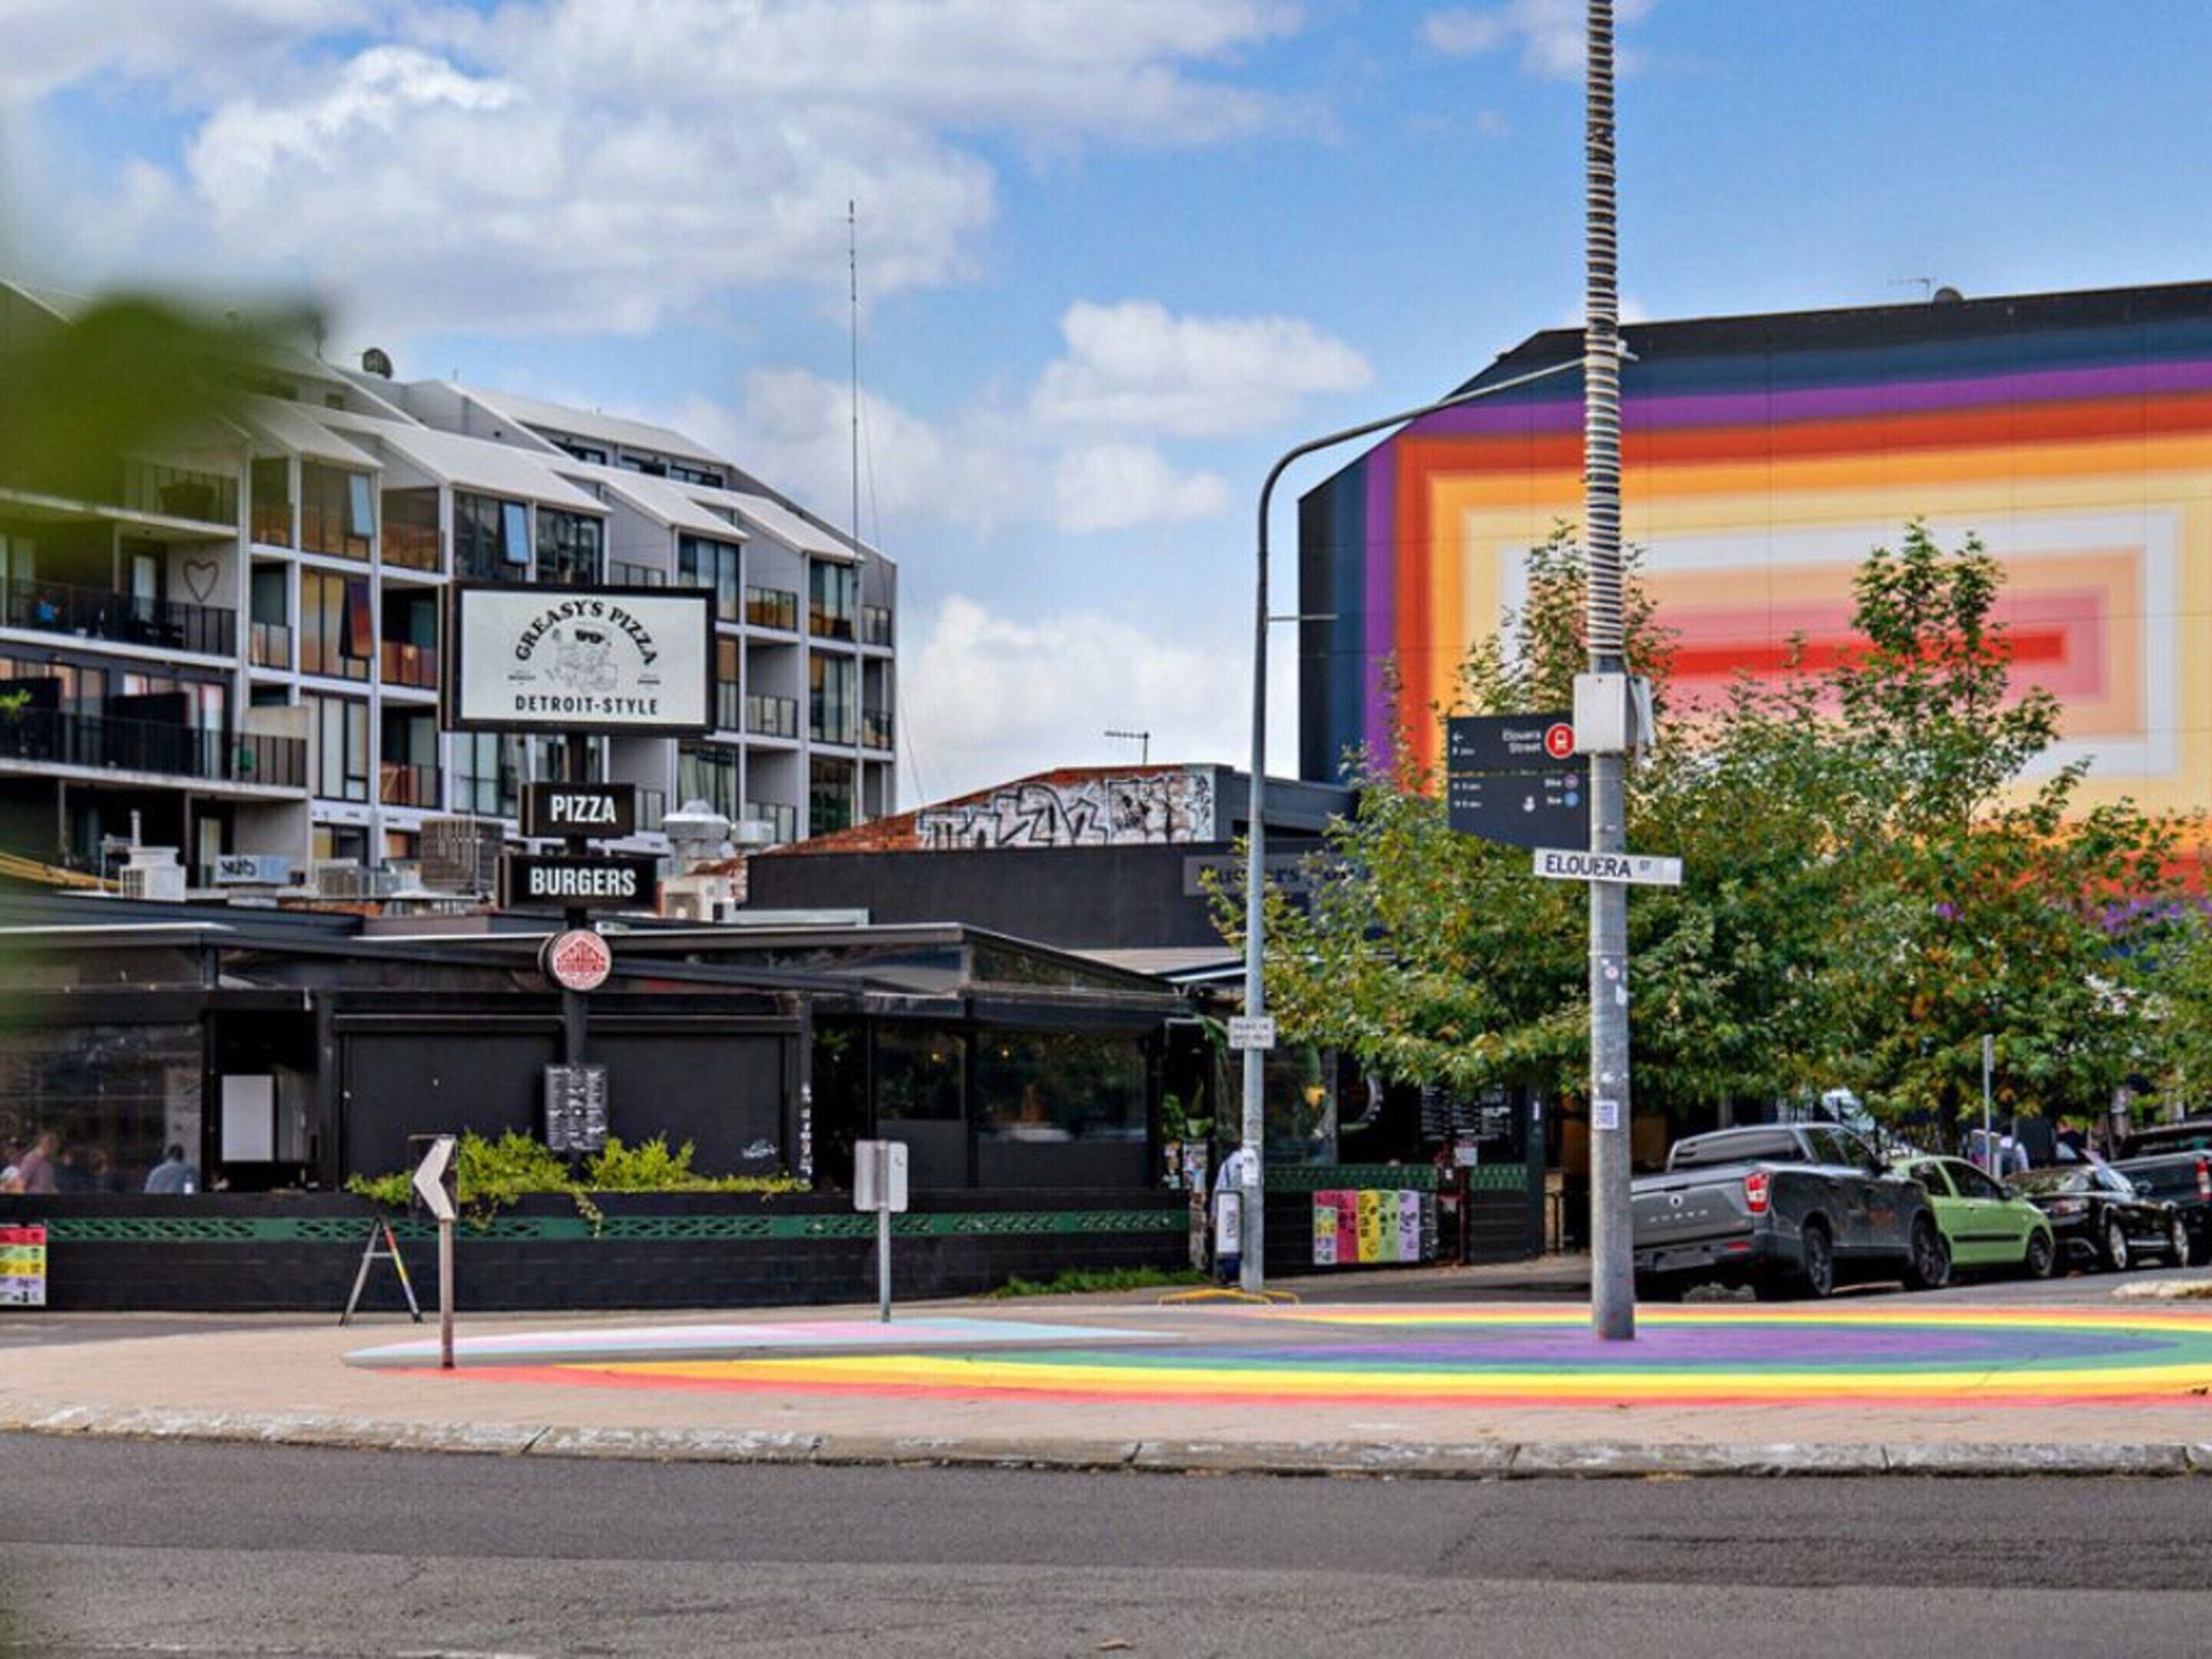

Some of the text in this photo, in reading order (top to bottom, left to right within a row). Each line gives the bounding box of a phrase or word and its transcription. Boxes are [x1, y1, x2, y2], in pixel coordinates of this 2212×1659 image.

[515, 600, 657, 665] GREASY'S PIZZA
[515, 695, 657, 715] DETROIT-STYLE
[550, 795, 616, 823] PIZZA
[1545, 853, 1631, 878] ELOUERA
[530, 866, 636, 897] BURGERS
